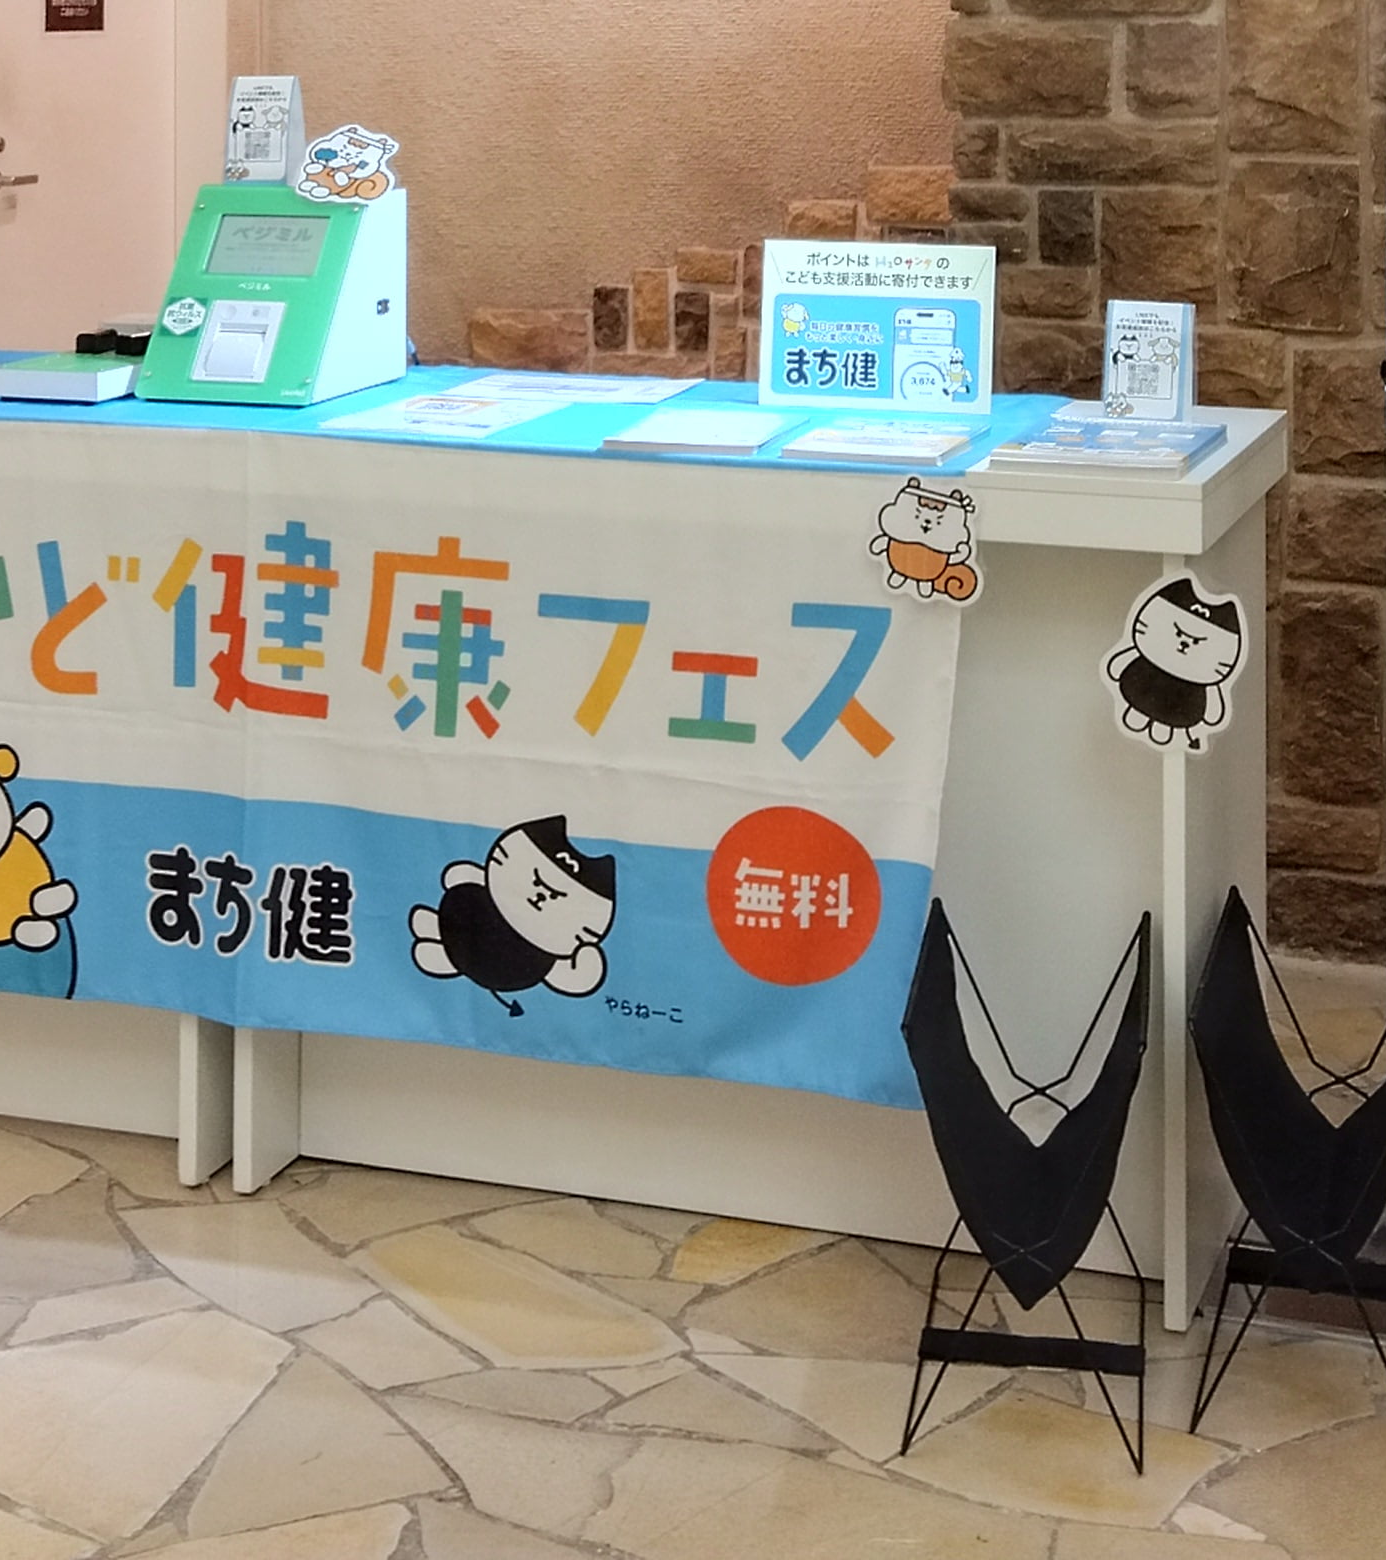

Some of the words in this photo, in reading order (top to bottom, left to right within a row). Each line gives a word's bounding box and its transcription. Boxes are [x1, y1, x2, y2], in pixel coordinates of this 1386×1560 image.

[806, 252, 869, 269] ポイントは
[936, 256, 950, 270] の
[784, 270, 974, 290] こども支援活動に寄付できます
[784, 347, 878, 389] まち健
[144, 844, 354, 966] まち健
[733, 857, 855, 930] 無料
[604, 995, 685, 1025] やらねーこ
